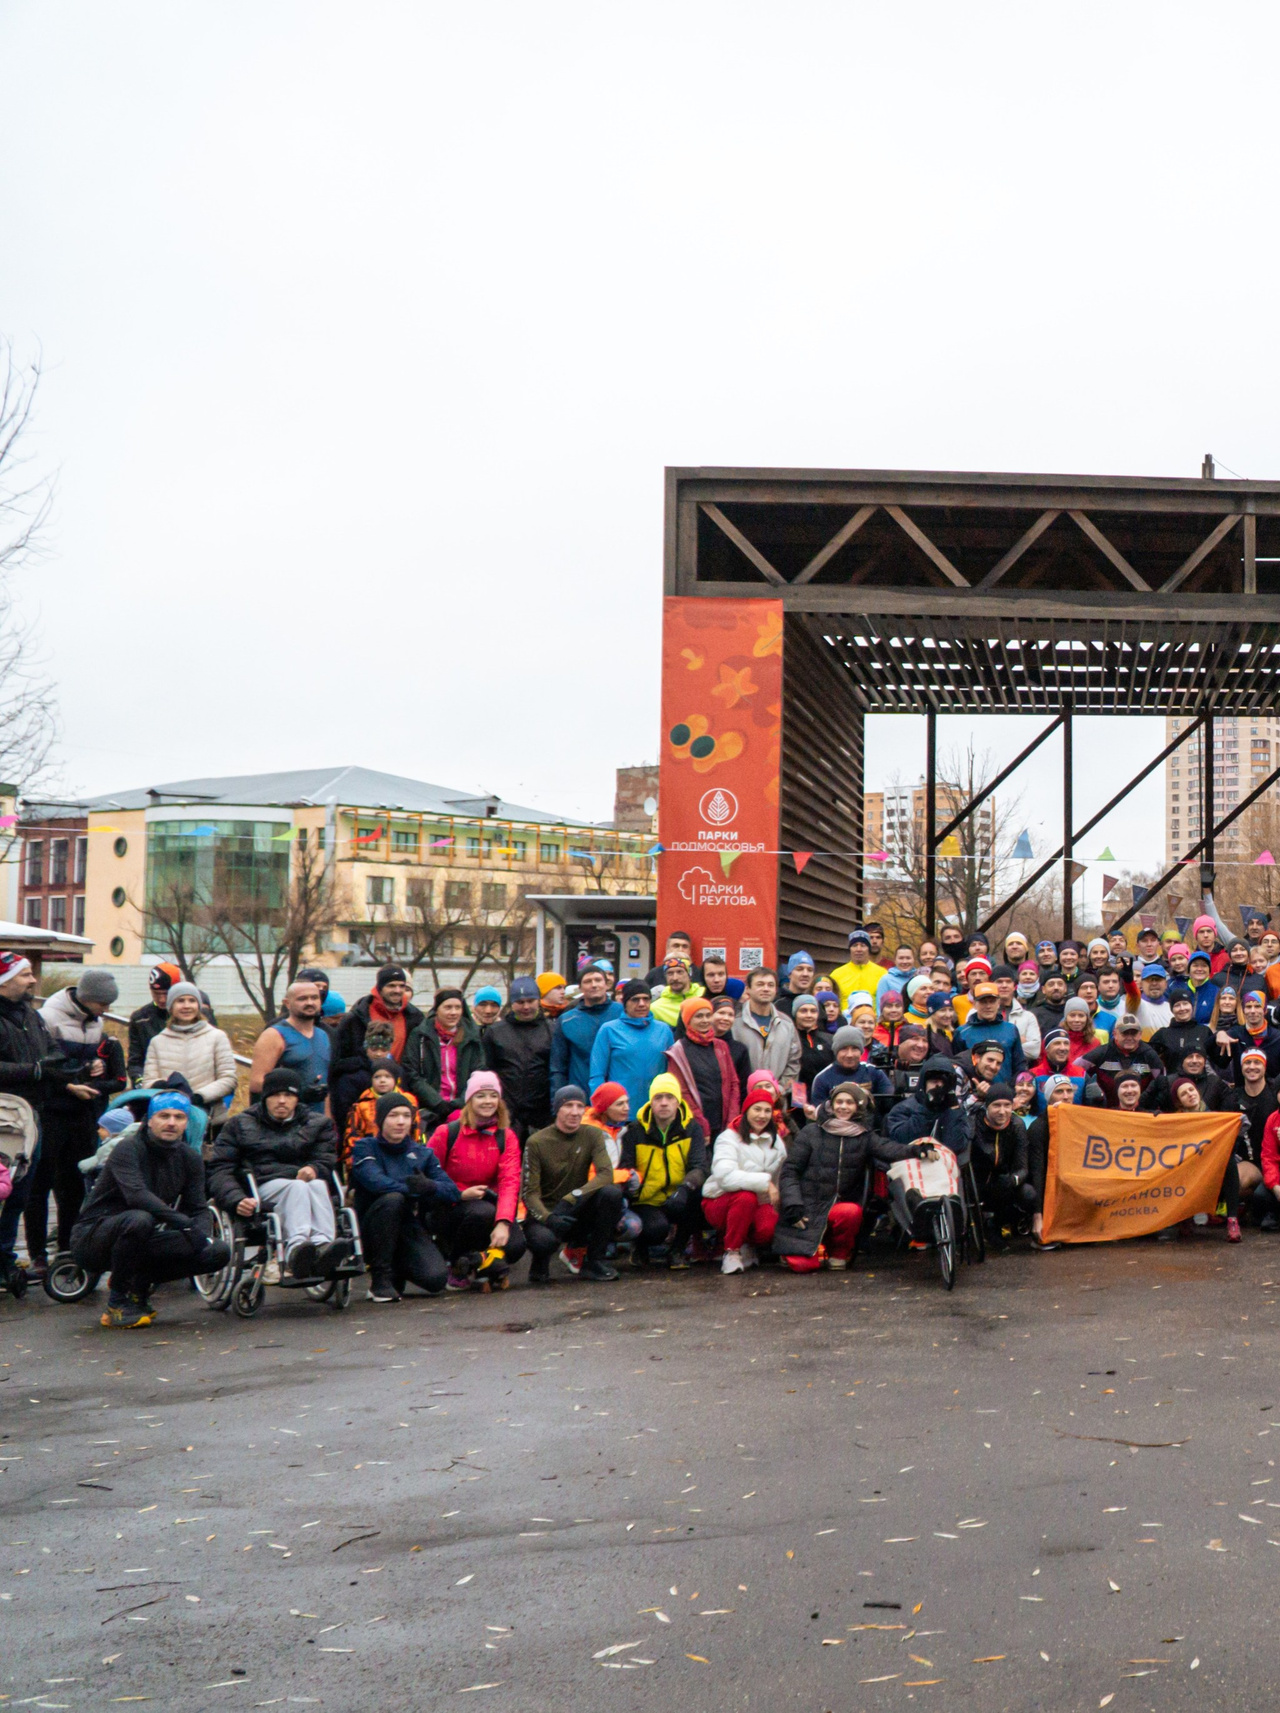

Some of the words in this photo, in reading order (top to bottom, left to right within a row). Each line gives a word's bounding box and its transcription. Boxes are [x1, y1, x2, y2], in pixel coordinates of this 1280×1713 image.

[698, 831, 738, 840] ПАРКИ
[671, 842, 765, 852] ПОДМОСКОВЬЯ
[699, 884, 744, 894] ПАРКИ
[699, 895, 757, 906] РЕУТОВА
[1110, 1206, 1160, 1218] МОСКВА
